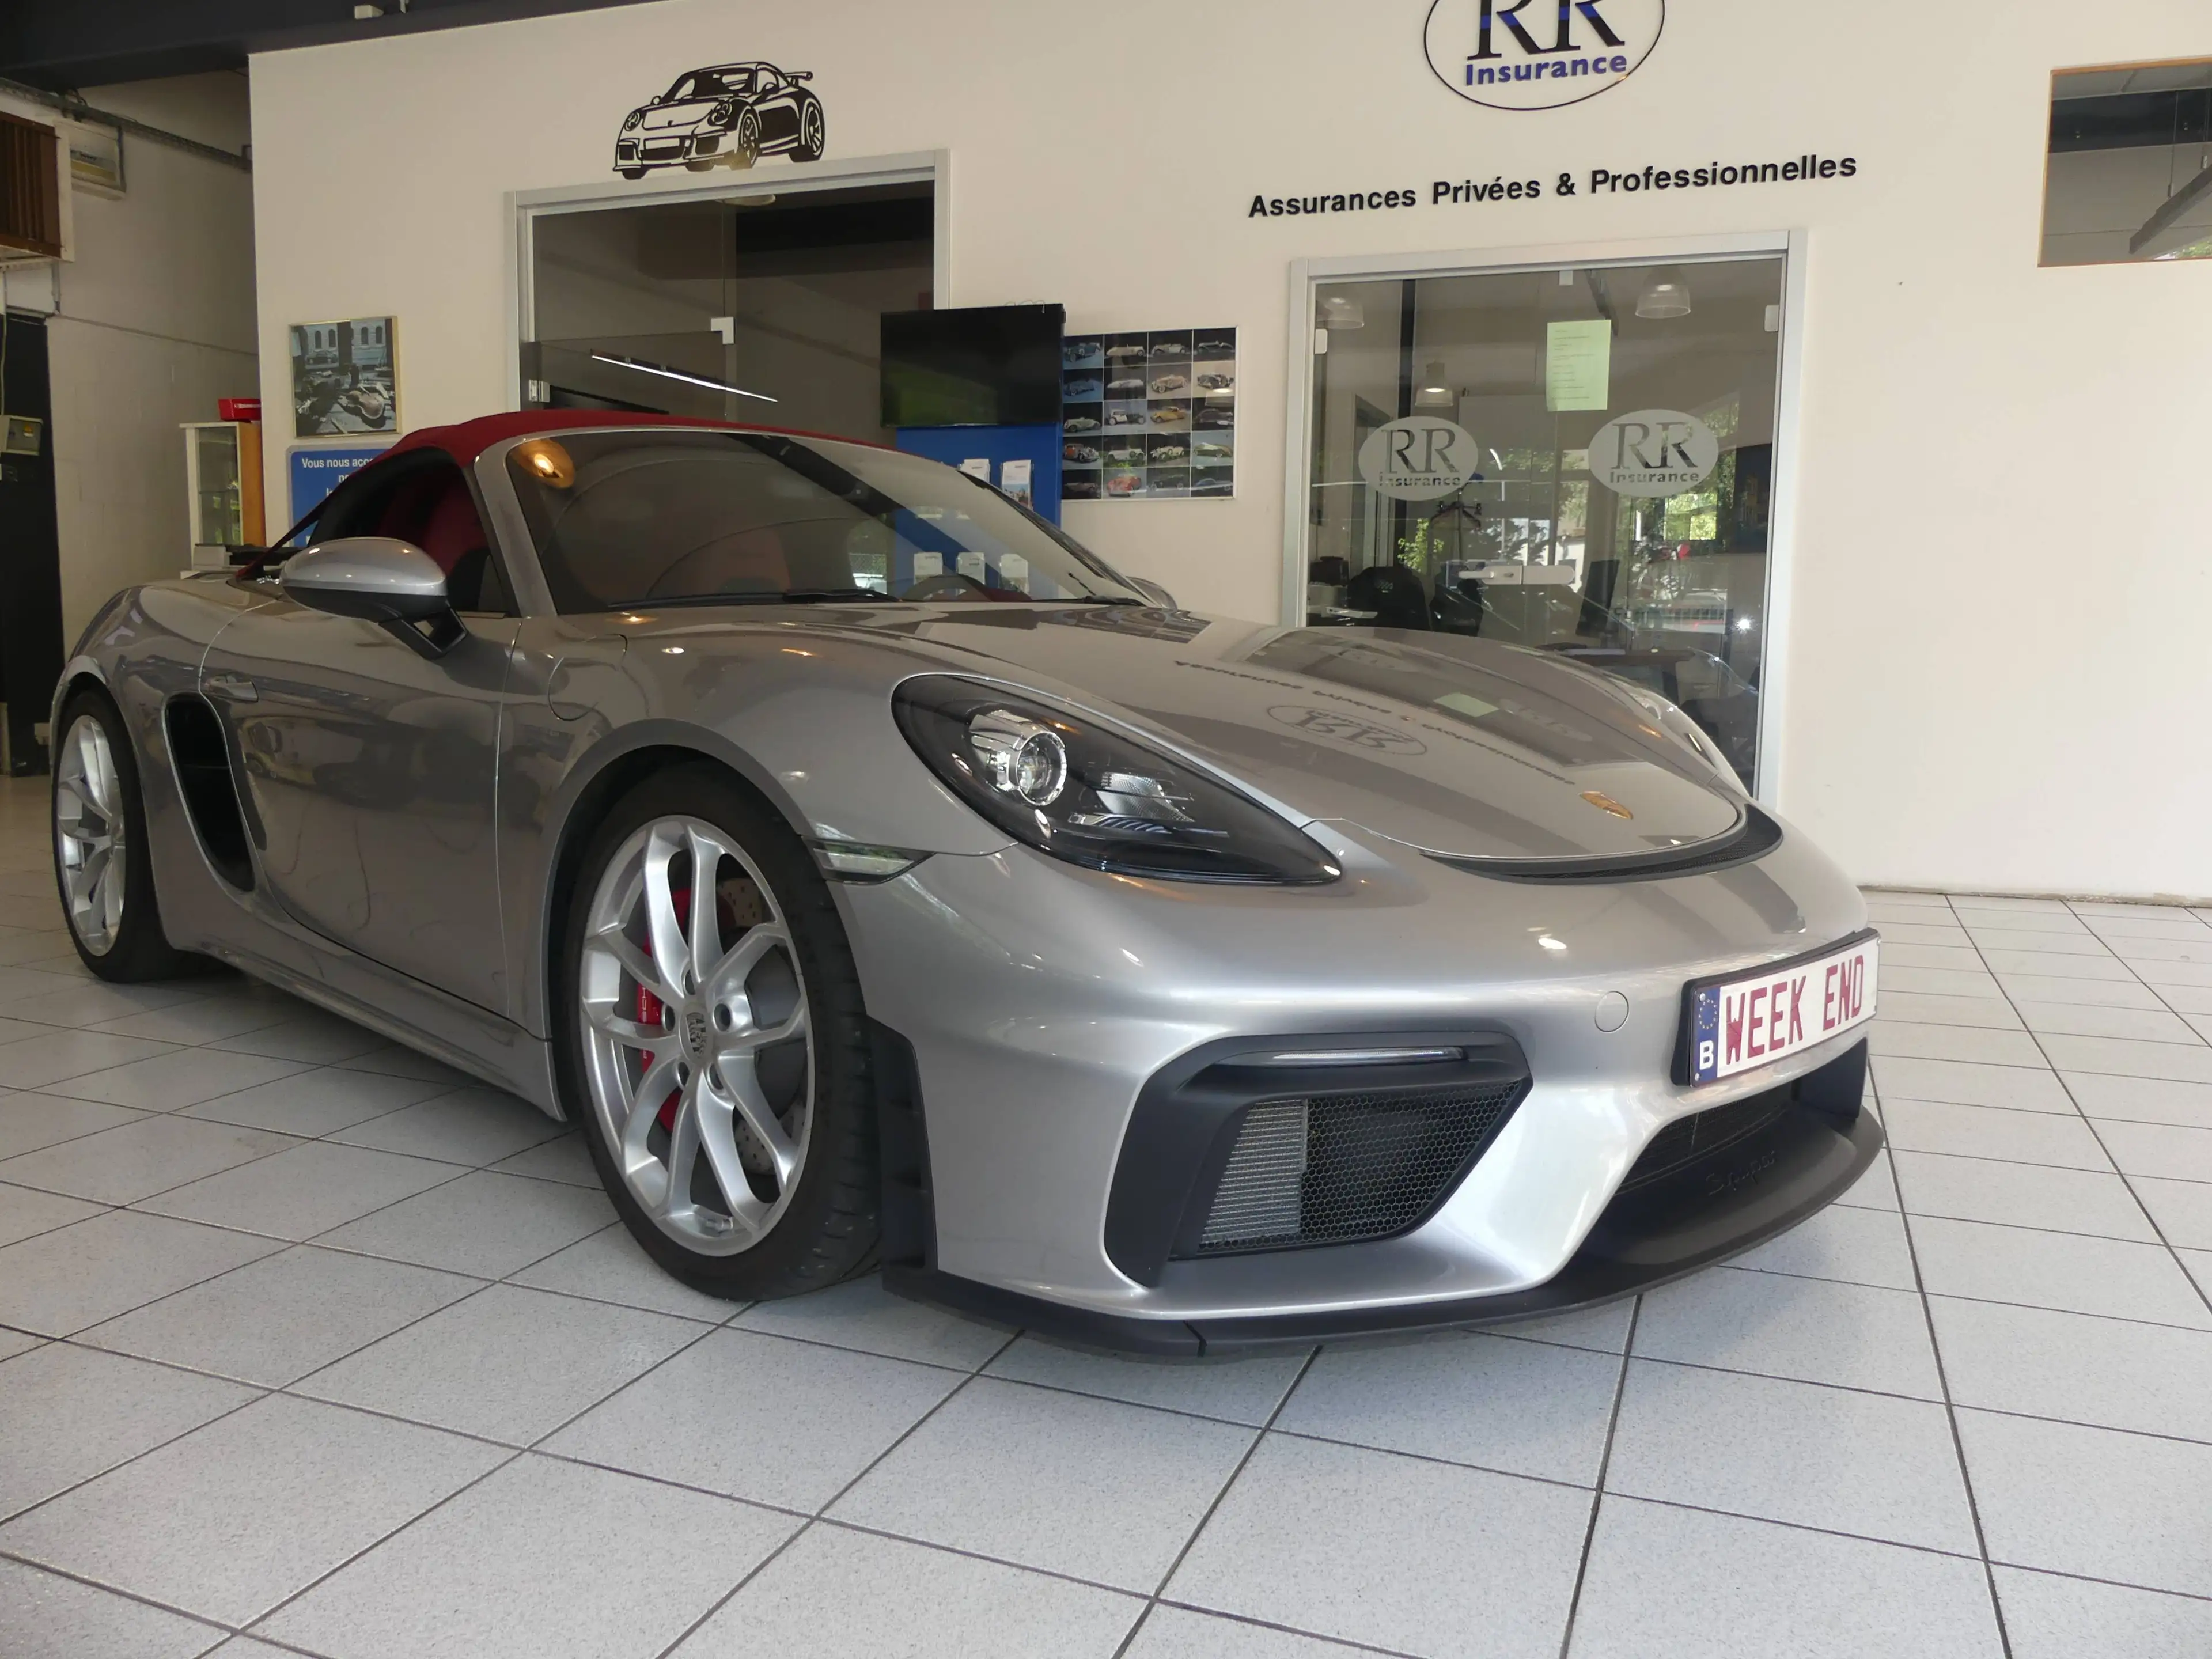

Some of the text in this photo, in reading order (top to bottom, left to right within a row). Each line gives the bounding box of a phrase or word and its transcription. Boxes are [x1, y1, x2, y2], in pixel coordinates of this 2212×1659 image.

[1467, 0, 1624, 60] RR
[1465, 55, 1627, 86] Insurance
[1248, 154, 1857, 218] Assurances Privées & Professionnelles
[301, 457, 325, 468] Vous
[327, 459, 350, 468] nous
[1381, 428, 1460, 474] RR
[1611, 421, 1699, 469] RR
[1379, 472, 1461, 487] Insurance
[1609, 471, 1699, 483] Insurance
[1726, 954, 1864, 1066] WEEK END
[1699, 1040, 1714, 1070] B
